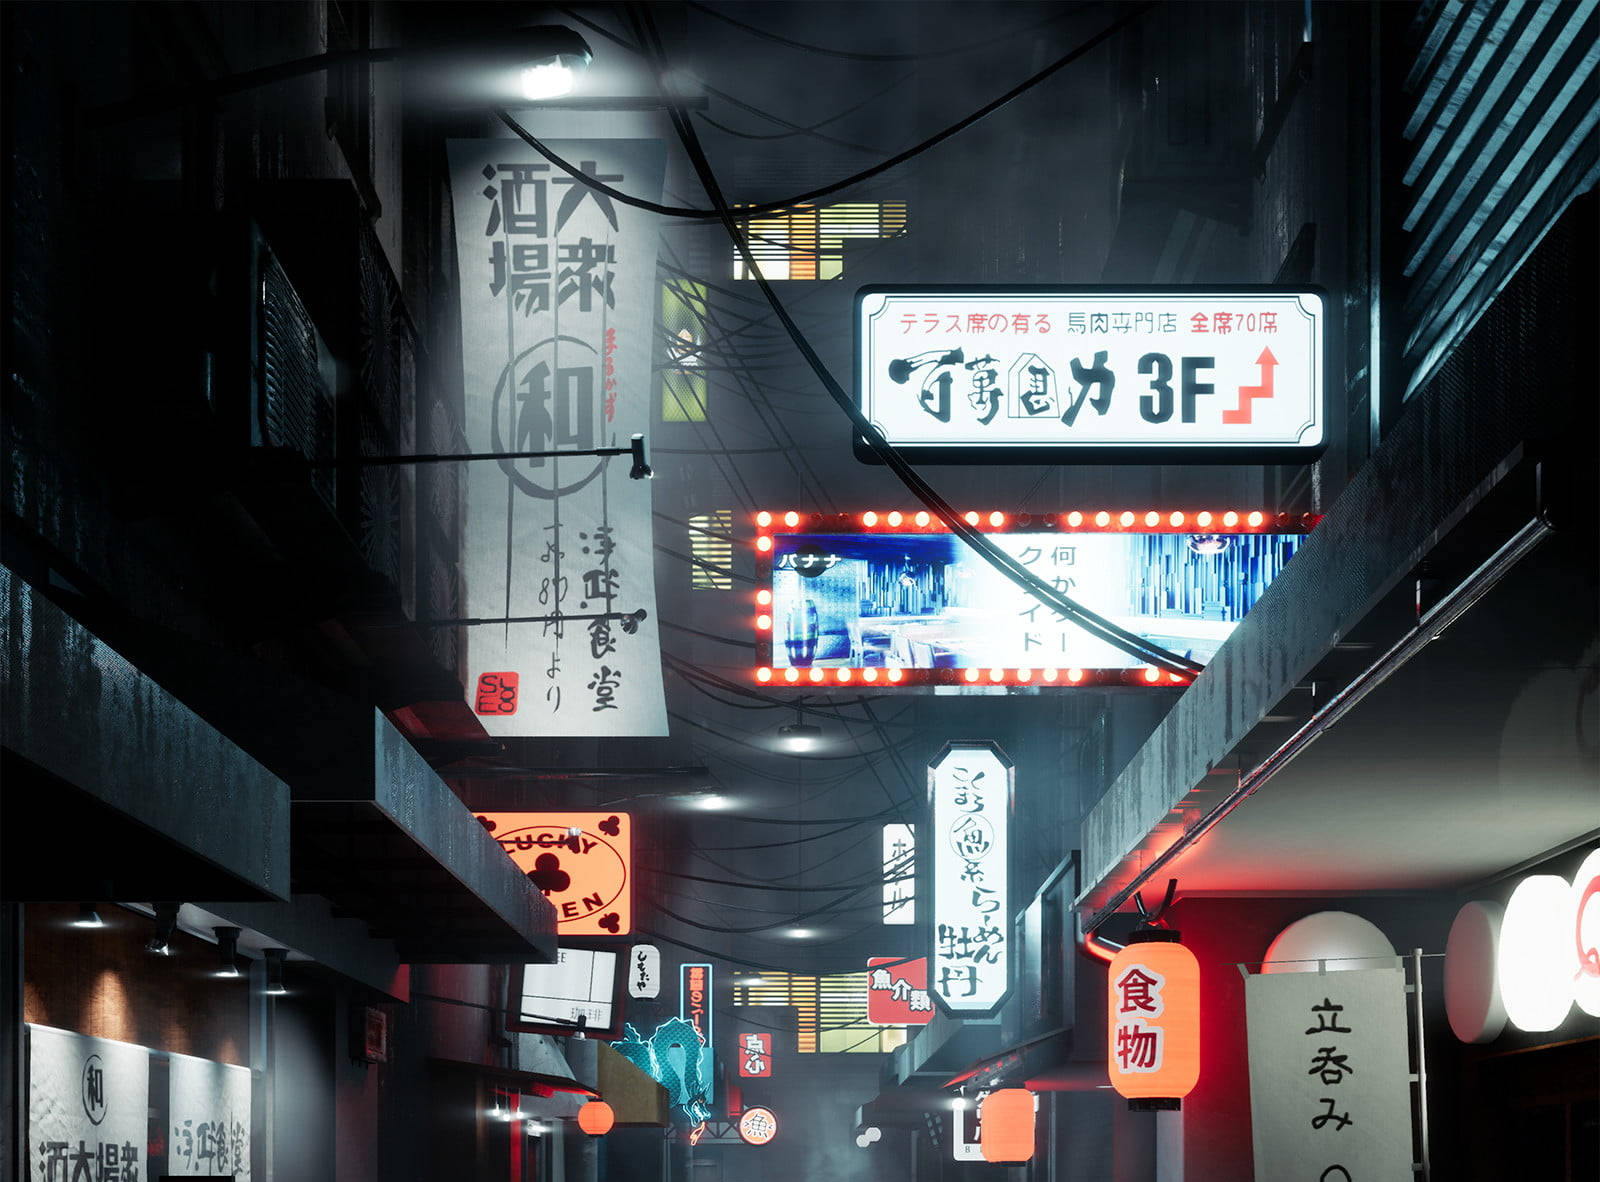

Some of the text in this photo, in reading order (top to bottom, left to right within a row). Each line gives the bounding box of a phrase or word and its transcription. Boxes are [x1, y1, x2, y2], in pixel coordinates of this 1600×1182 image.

[900, 312, 1052, 335] テラス席の有る
[1189, 312, 1278, 334] 全席70席
[1137, 352, 1216, 424] 3F
[778, 553, 842, 568] バナナ
[1018, 546, 1043, 652] クイド
[1050, 546, 1077, 653] 何かー
